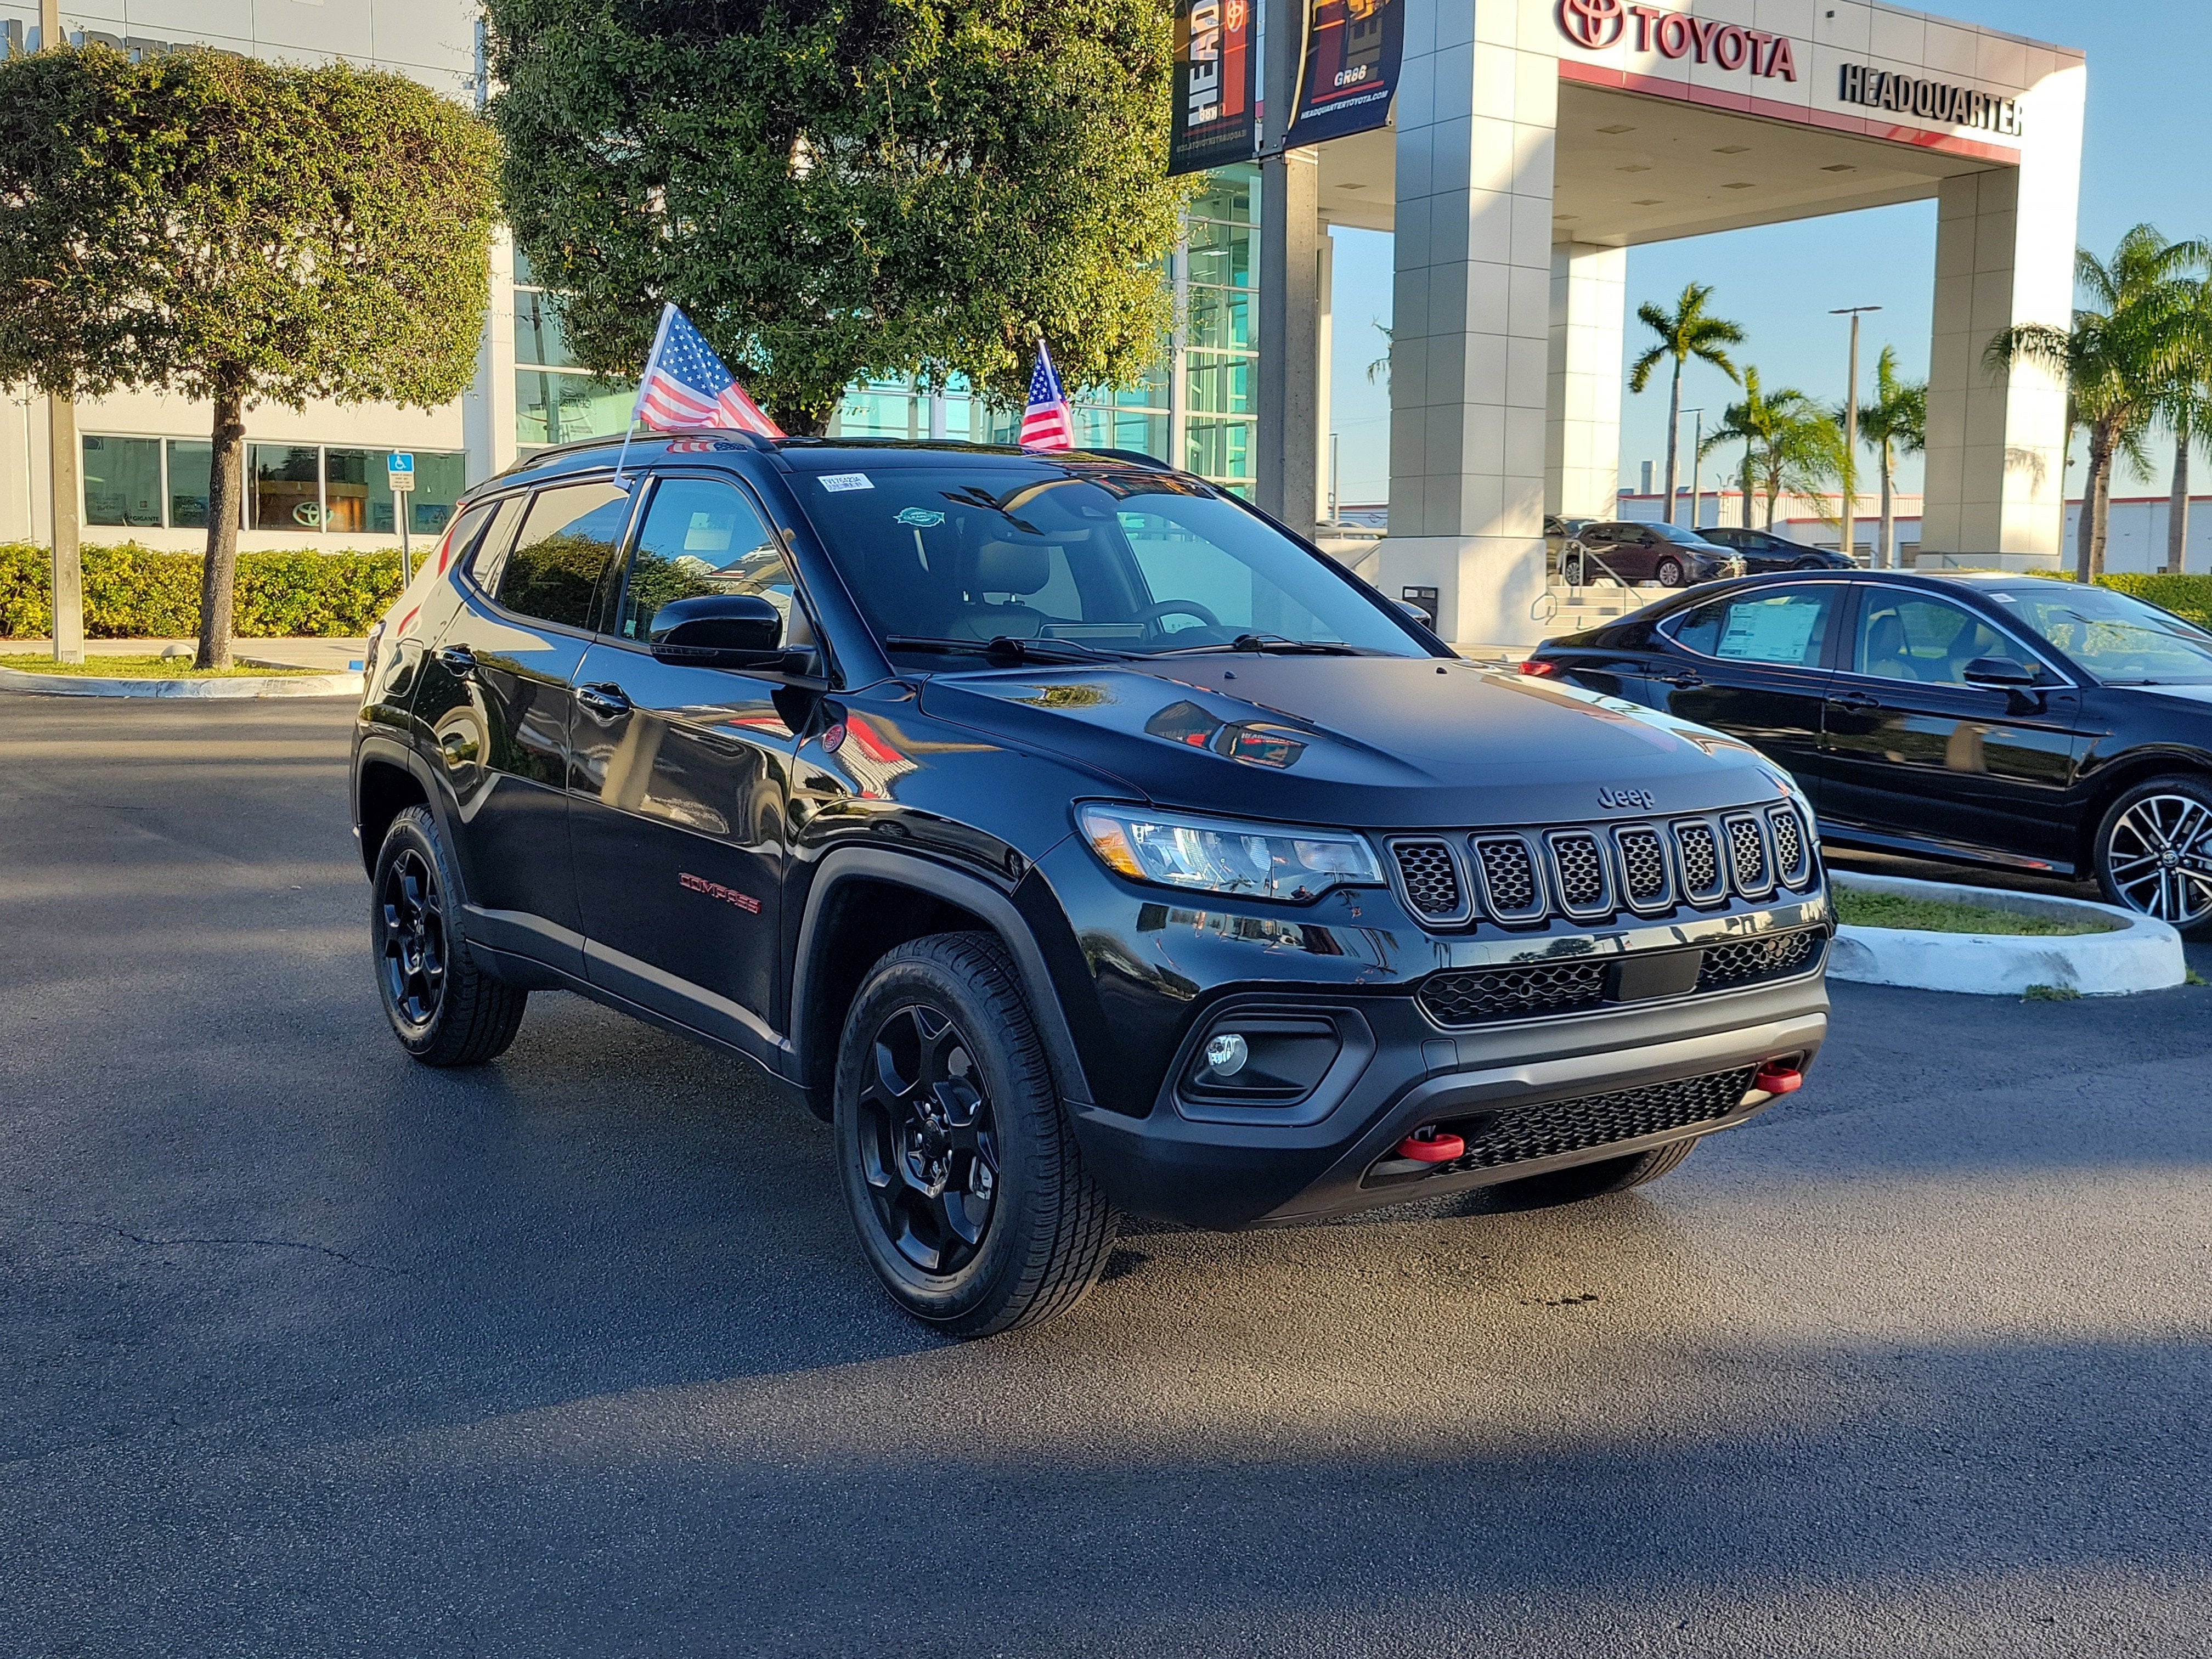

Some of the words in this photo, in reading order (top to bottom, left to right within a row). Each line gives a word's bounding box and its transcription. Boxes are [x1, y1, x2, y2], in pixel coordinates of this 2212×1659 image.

[1628, 5, 1797, 81] TOYOTA
[1334, 65, 1367, 87] GR86
[1300, 90, 1389, 120] HEADQUARTERTOYOTA.COM
[1597, 786, 1655, 810] Jeep
[678, 872, 762, 914] COMPASS
